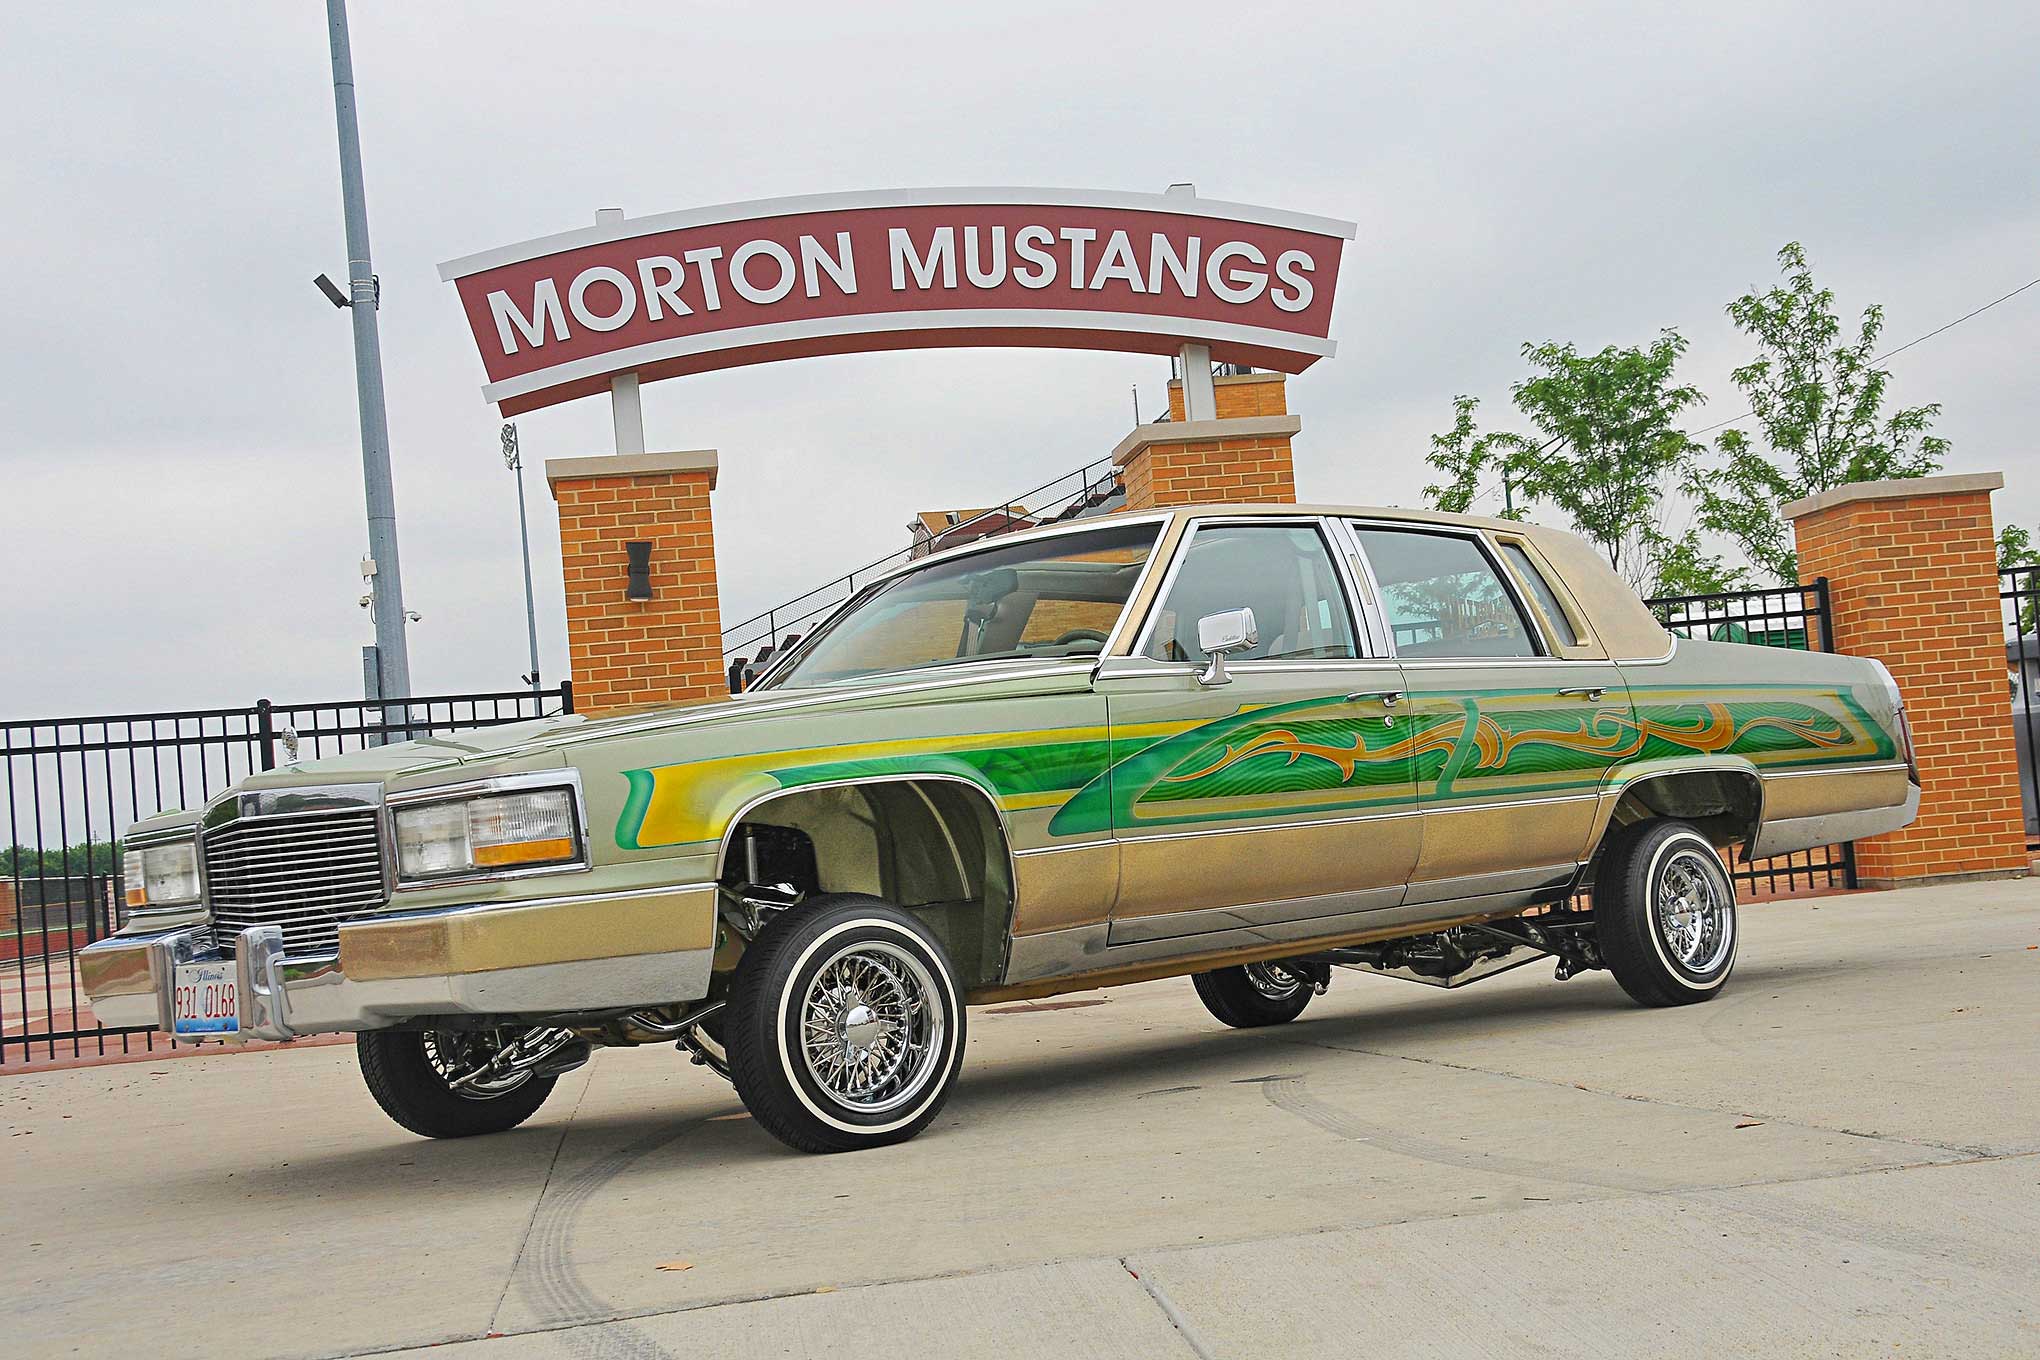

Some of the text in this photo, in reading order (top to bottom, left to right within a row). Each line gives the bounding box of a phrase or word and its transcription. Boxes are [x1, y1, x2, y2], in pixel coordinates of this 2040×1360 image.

[486, 226, 1316, 355] MORTON MUSTANGS
[190, 969, 223, 984] Illinois
[176, 984, 235, 1019] 931 0168
